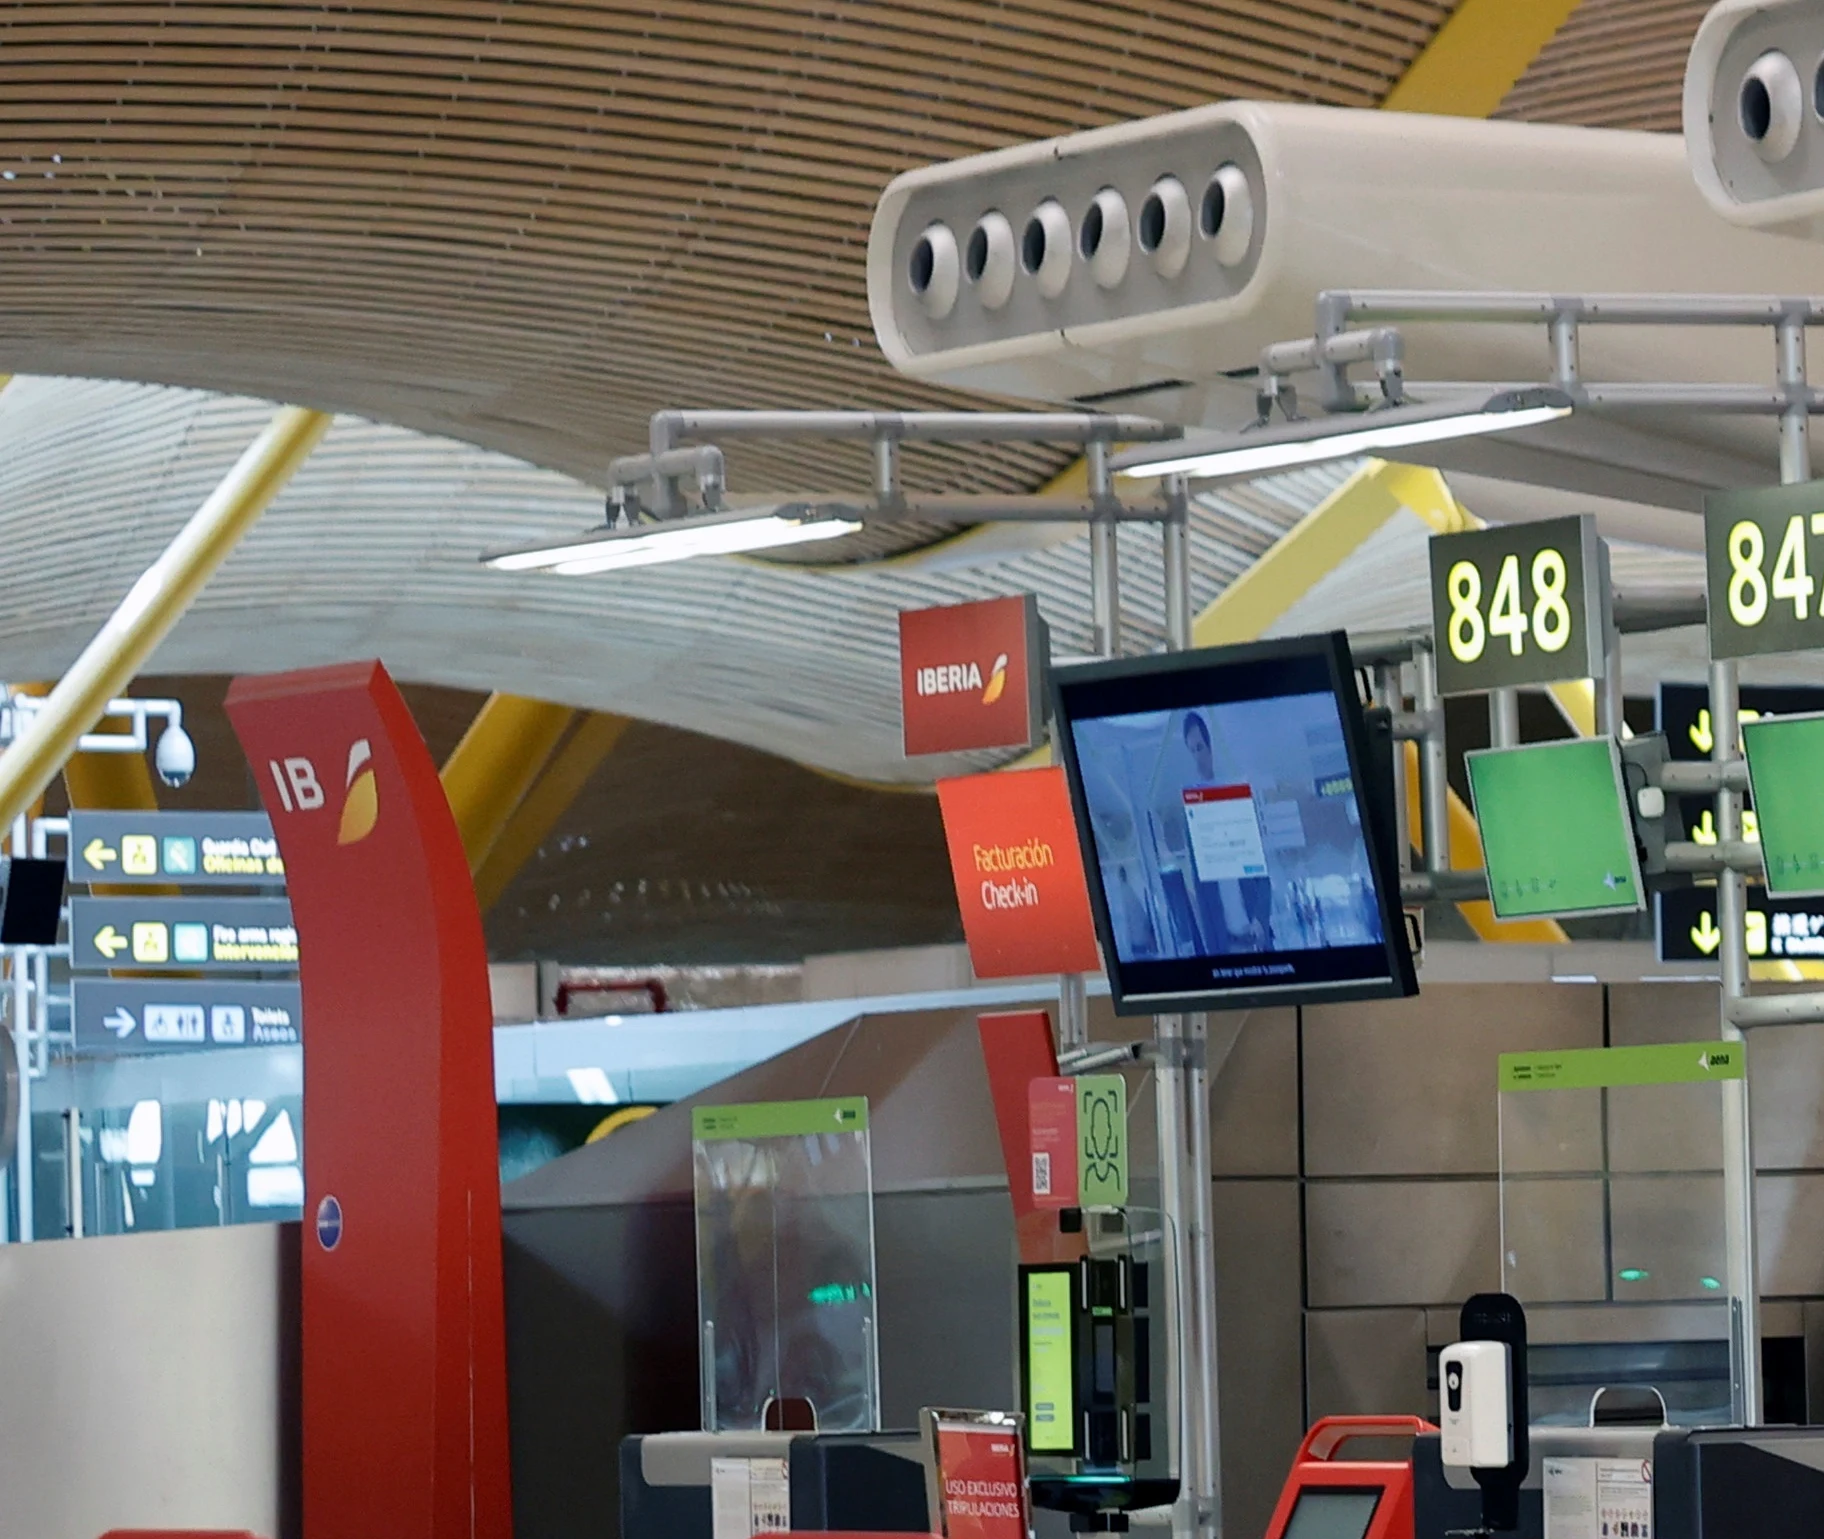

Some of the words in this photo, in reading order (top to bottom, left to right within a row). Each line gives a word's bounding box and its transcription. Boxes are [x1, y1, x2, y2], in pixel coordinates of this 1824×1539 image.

[1447, 547, 1571, 664] 848
[916, 662, 983, 696] IBERIA
[270, 756, 324, 812] IB
[972, 838, 1053, 873] Facturación
[981, 878, 1038, 909] Check-in
[945, 1479, 966, 1494] USO
[967, 1480, 1018, 1498] EXCLUSIVO
